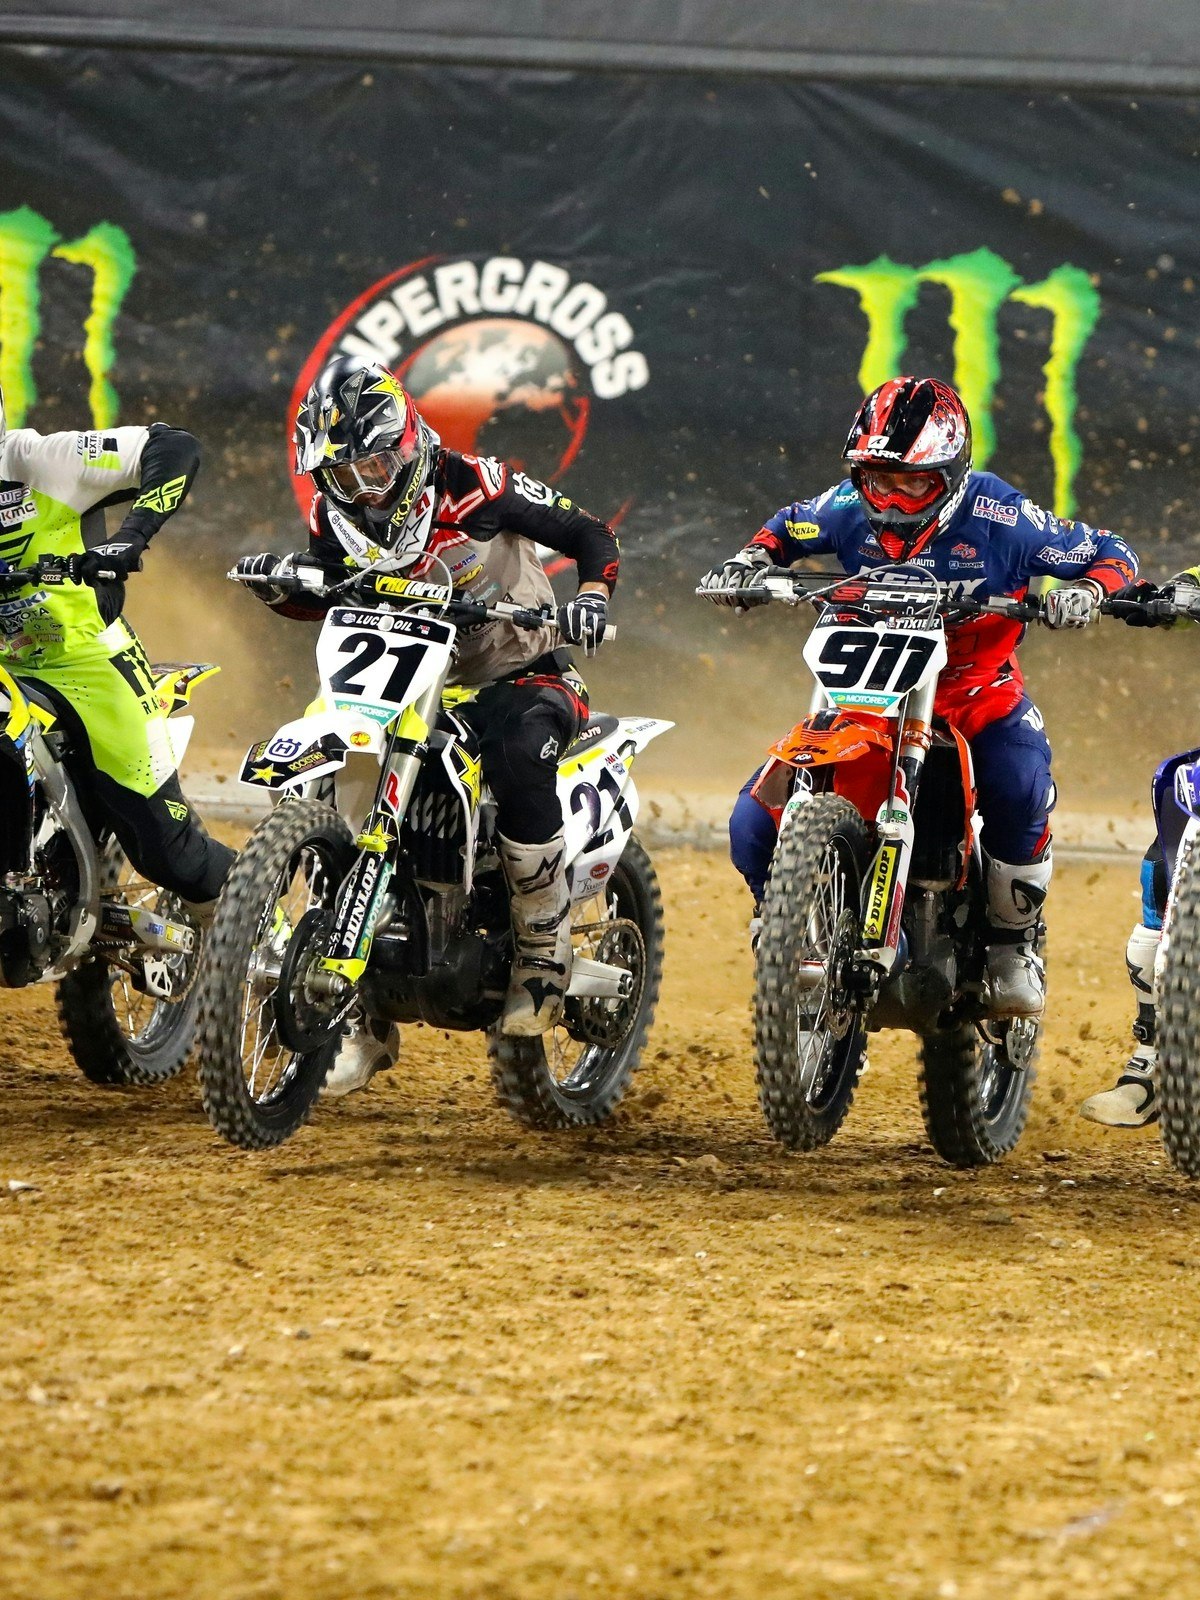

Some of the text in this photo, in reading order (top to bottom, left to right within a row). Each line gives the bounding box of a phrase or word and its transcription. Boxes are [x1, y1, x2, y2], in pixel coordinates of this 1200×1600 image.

[328, 257, 650, 400] UPERCROSS
[847, 448, 903, 461] SHARK
[336, 518, 363, 554] Husqvarna
[0, 590, 48, 615] ZUKI
[356, 614, 381, 627] LUC
[394, 620, 413, 632] OIL
[329, 632, 429, 704] 21
[815, 631, 939, 694] 911
[350, 704, 392, 719] MOTOREX
[846, 694, 890, 705] MOTOREX
[350, 732, 371, 746] FMF
[570, 766, 634, 855] 21
[871, 850, 893, 921] DUNLOP
[341, 857, 378, 958] DUNLOP
